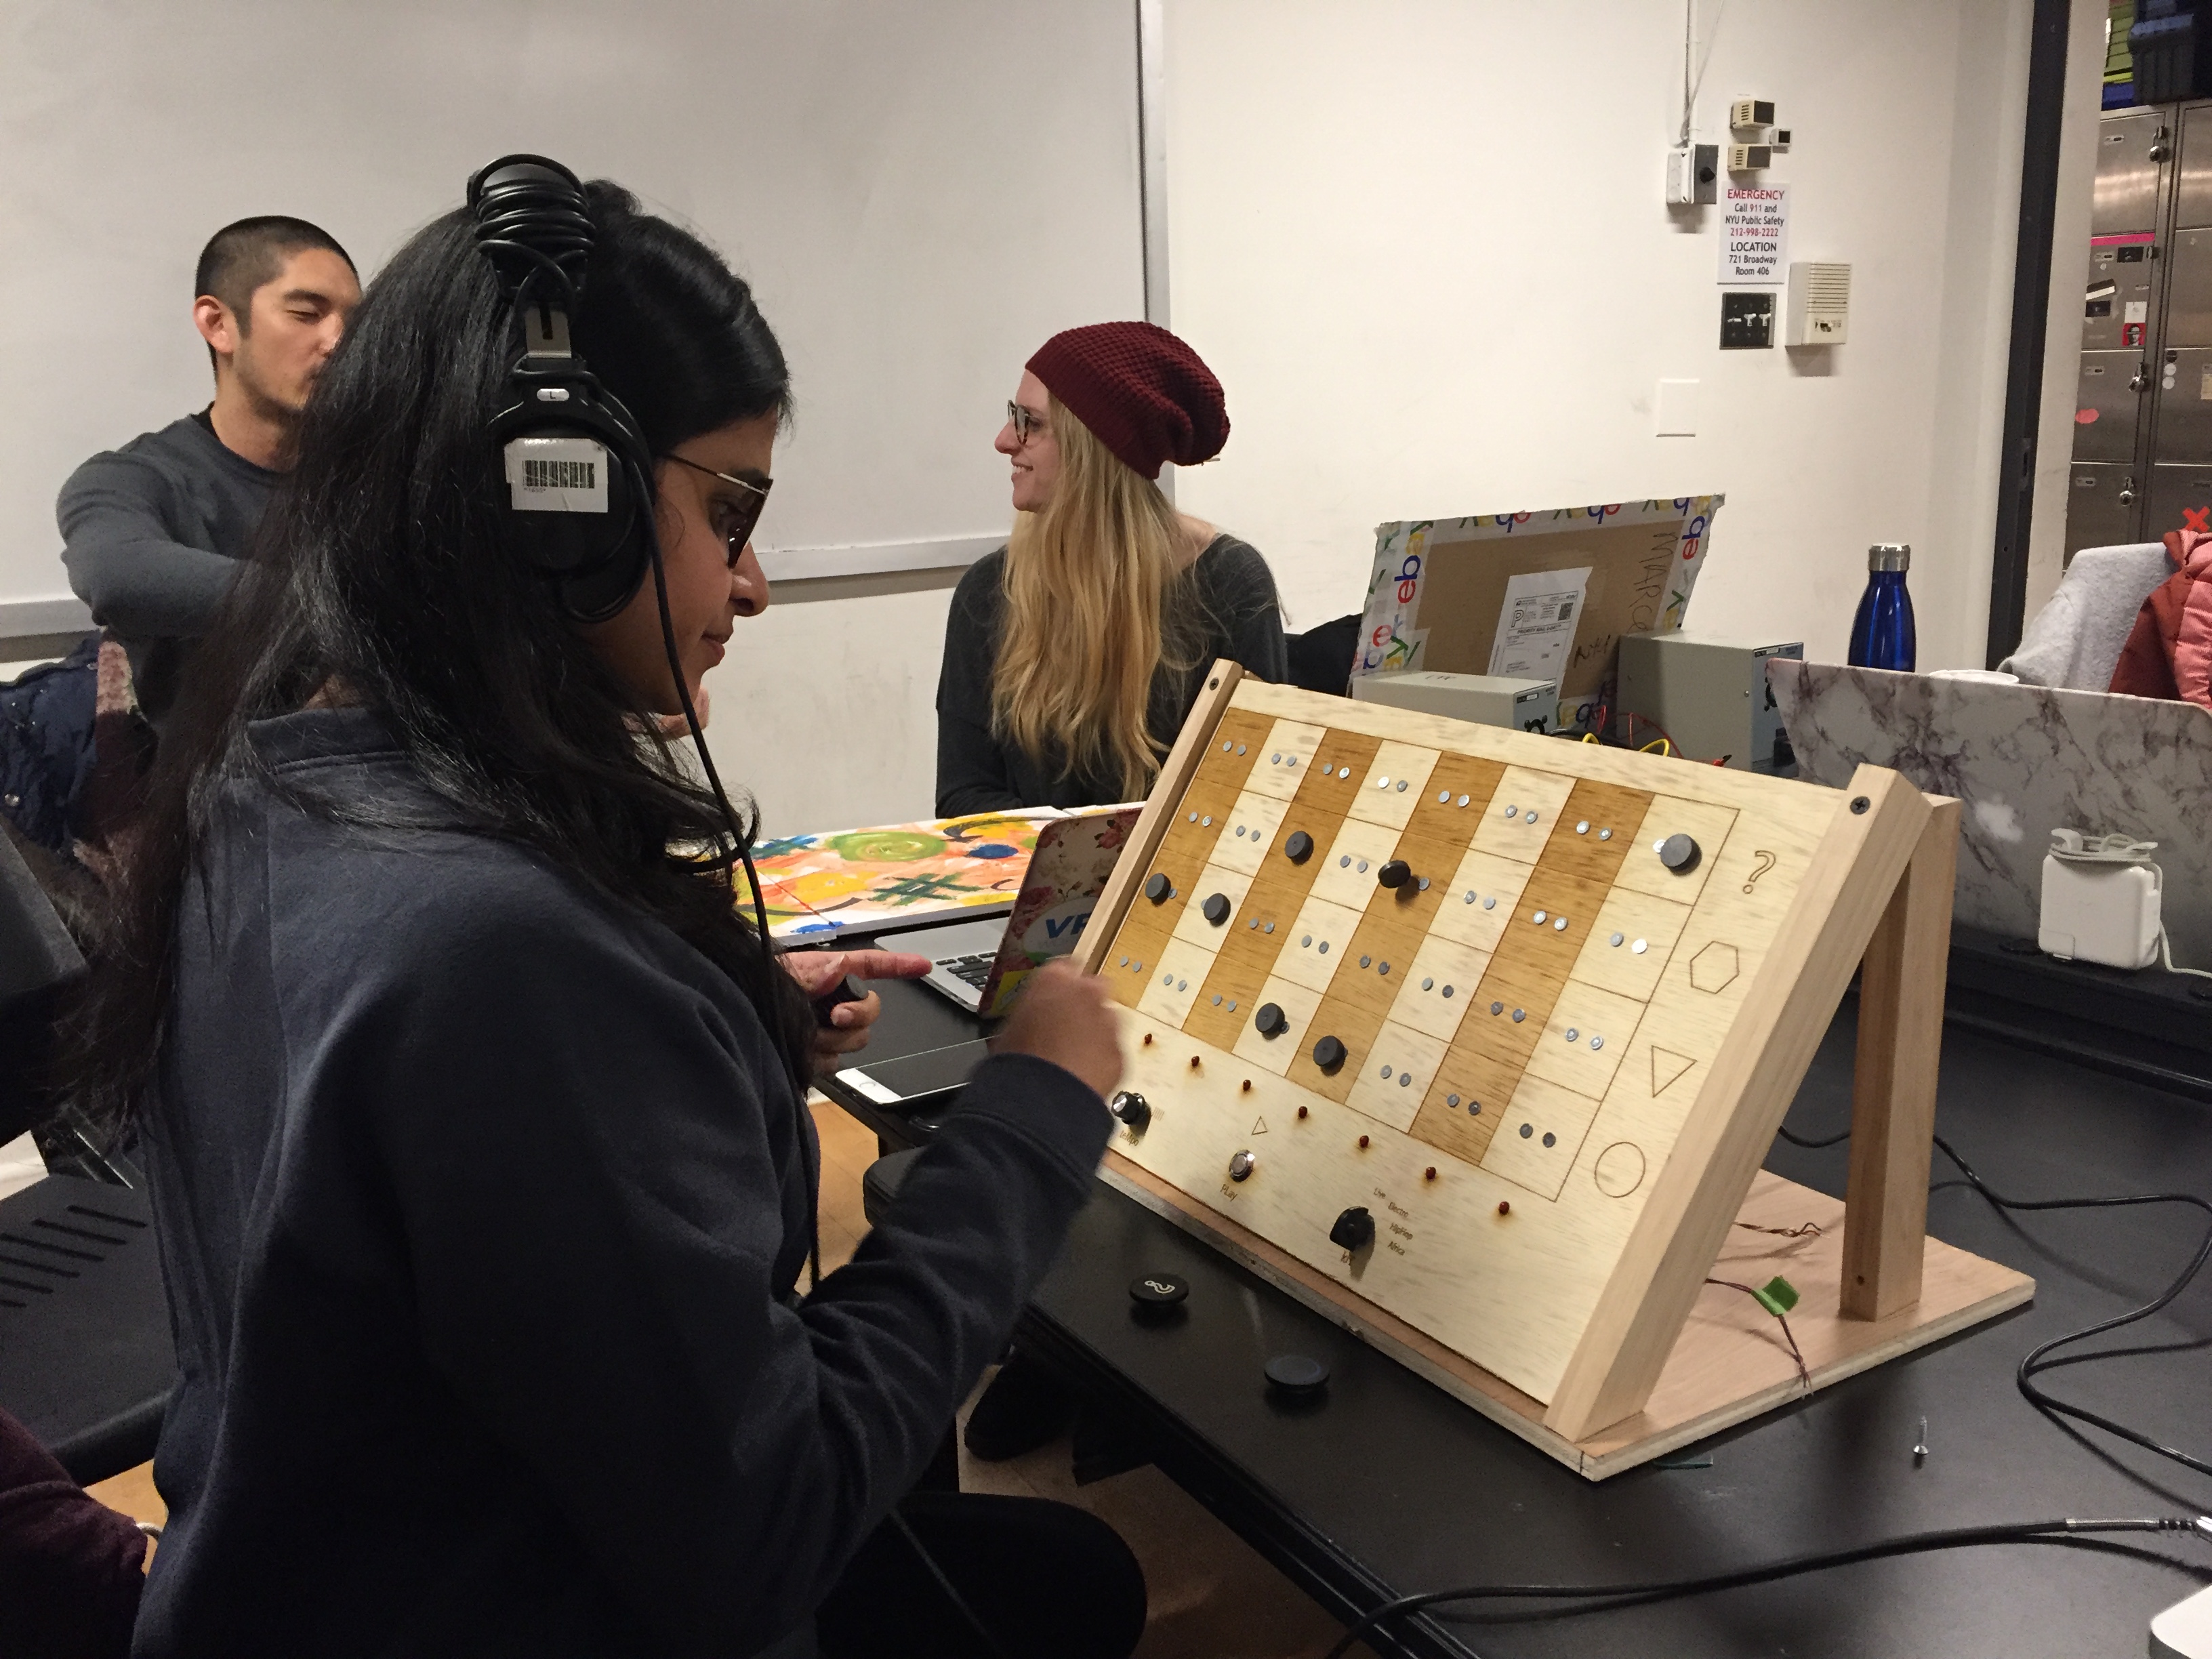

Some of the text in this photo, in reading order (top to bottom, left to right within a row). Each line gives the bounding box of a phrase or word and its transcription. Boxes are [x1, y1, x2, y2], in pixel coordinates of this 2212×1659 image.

[1727, 189, 1784, 200] EMERGENCY
[1735, 203, 1777, 213] Call 911 and
[1725, 216, 1784, 227] NYU Public Safety
[1730, 228, 1778, 237] 212-998-2222
[1730, 242, 1777, 252] LOCATION
[1729, 255, 1778, 265] 721 Broadway
[1736, 266, 1769, 275] Room 406
[549, 391, 556, 400] L
[1388, 1202, 1409, 1218] Electro
[1387, 1241, 1406, 1256] Africa
